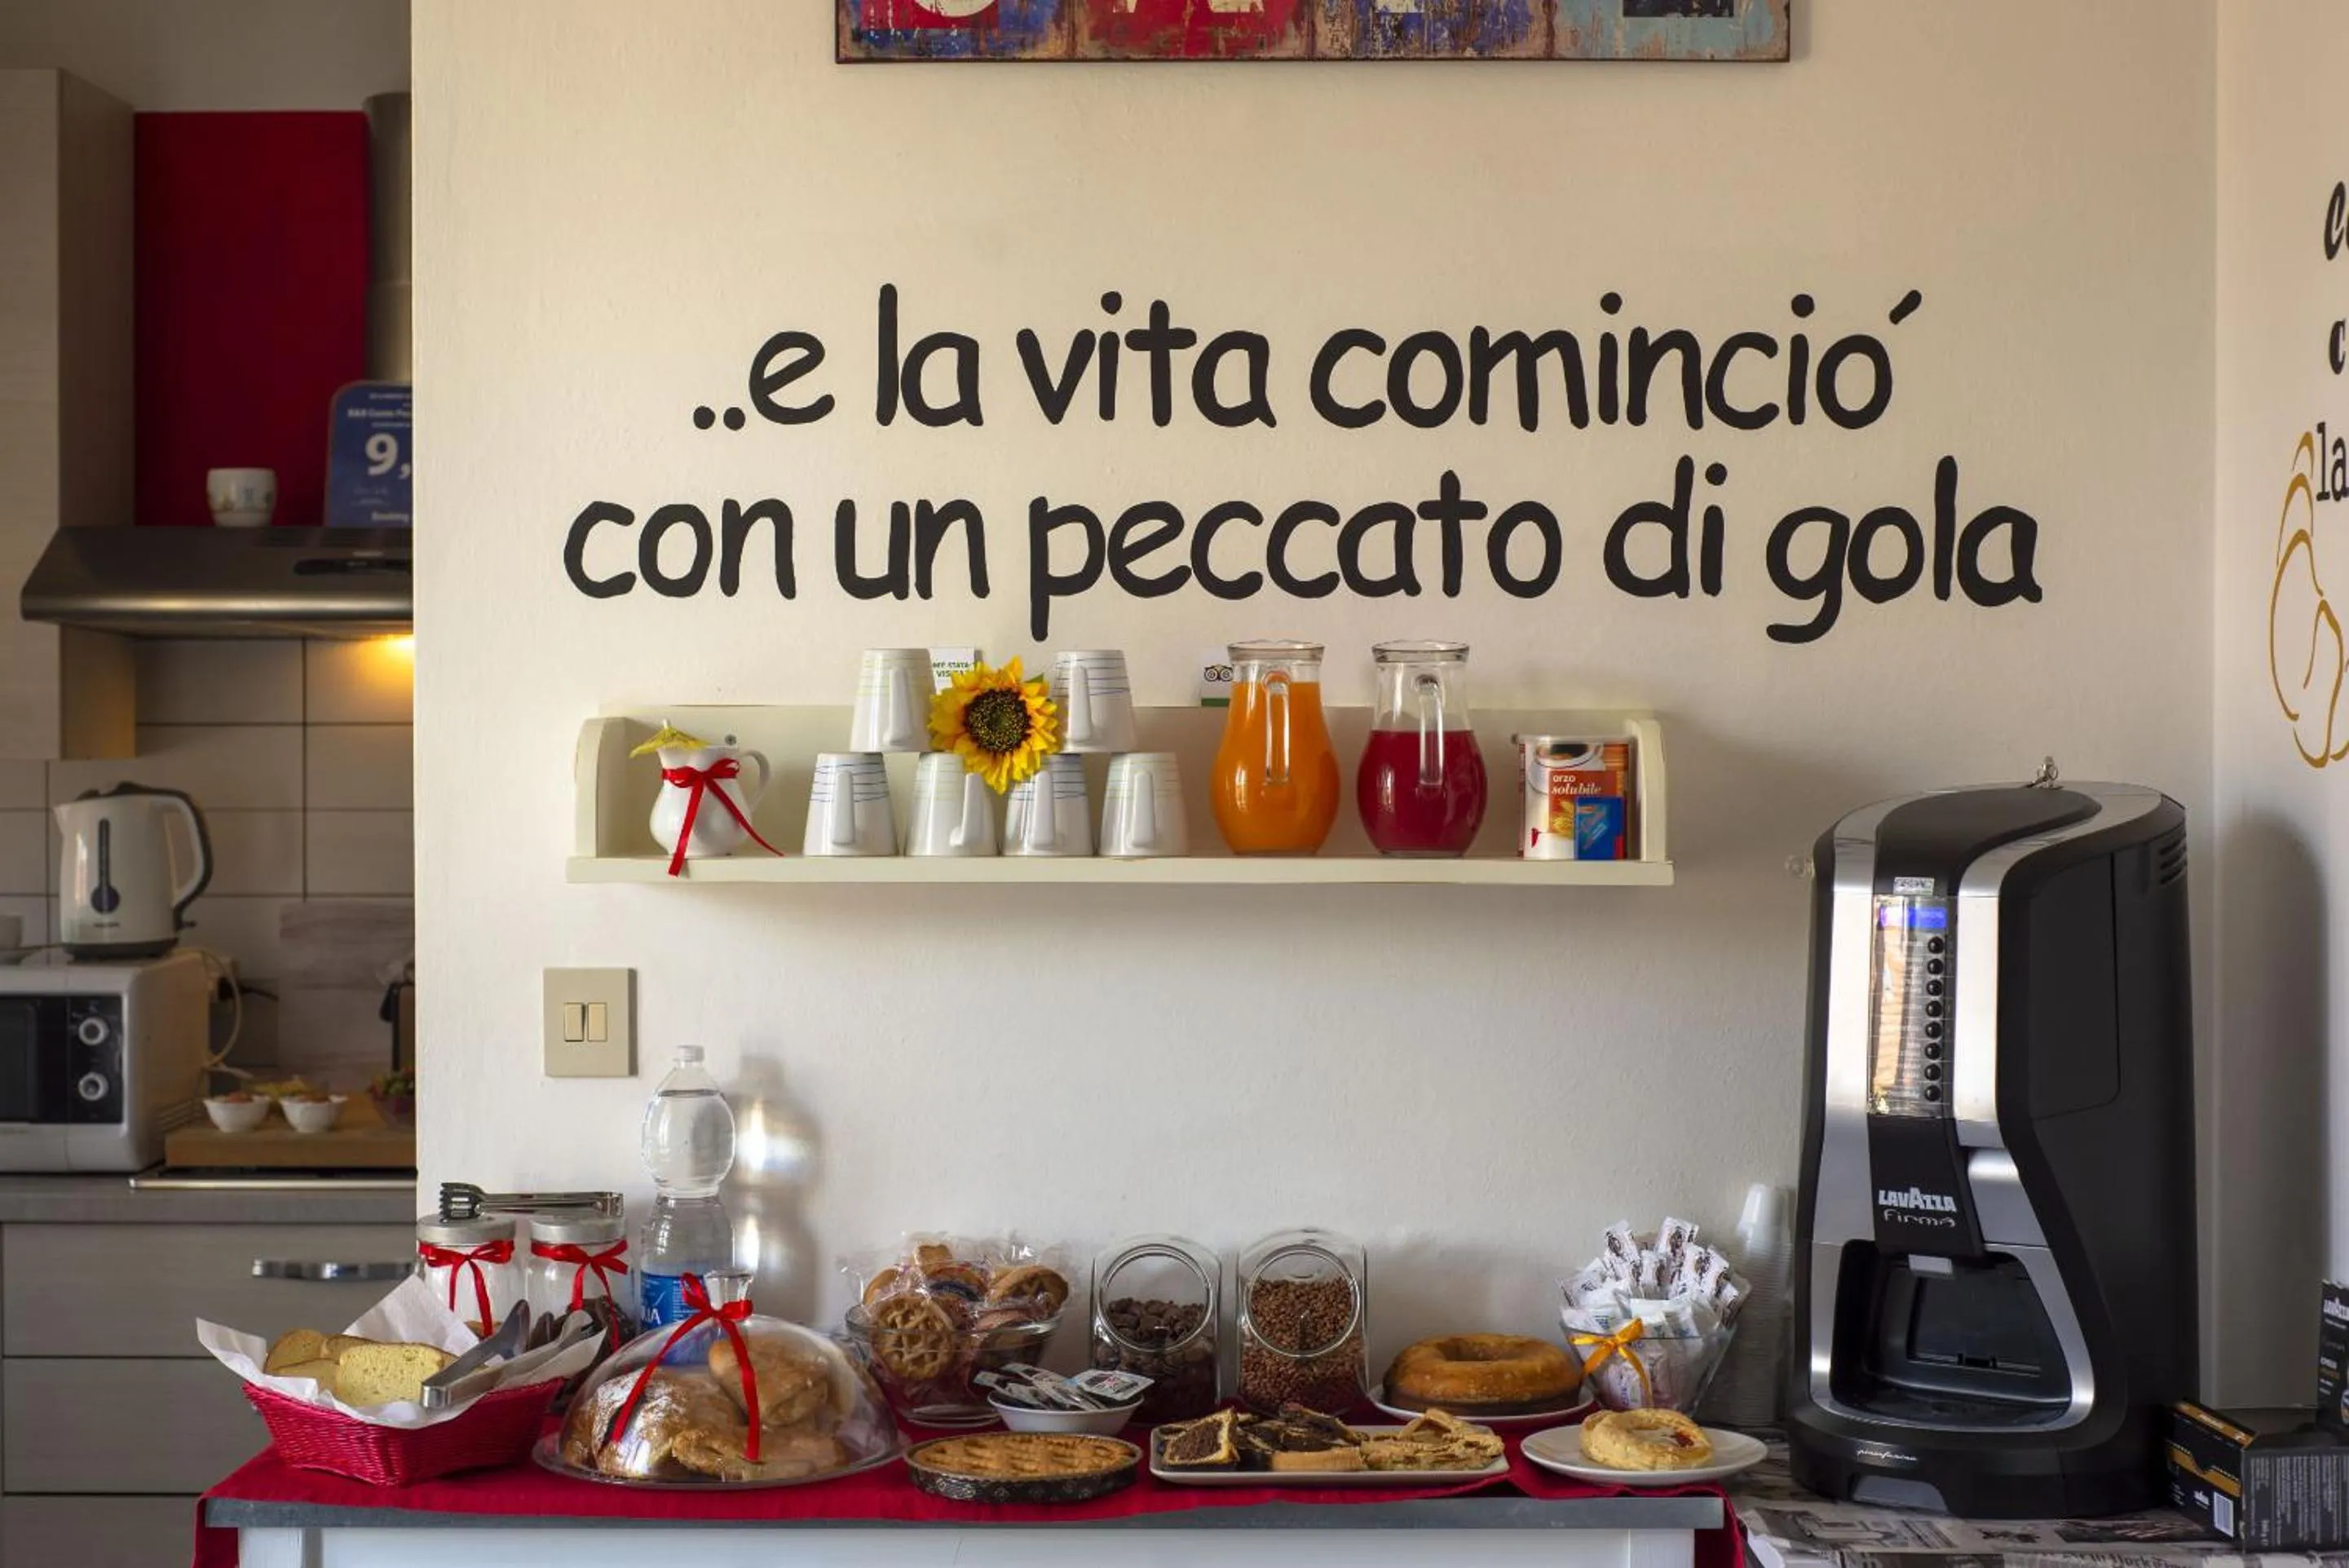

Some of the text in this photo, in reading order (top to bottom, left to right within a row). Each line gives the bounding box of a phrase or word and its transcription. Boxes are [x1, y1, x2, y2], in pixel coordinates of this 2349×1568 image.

[876, 283, 984, 427] la
[1016, 291, 1277, 428] vita
[563, 454, 2043, 644] con un peccato di gola
[1551, 783, 1601, 796] solubile
[1552, 775, 1576, 783] orzo
[1878, 1187, 1956, 1212] LAVAZZA
[1883, 1208, 1955, 1227] Firma
